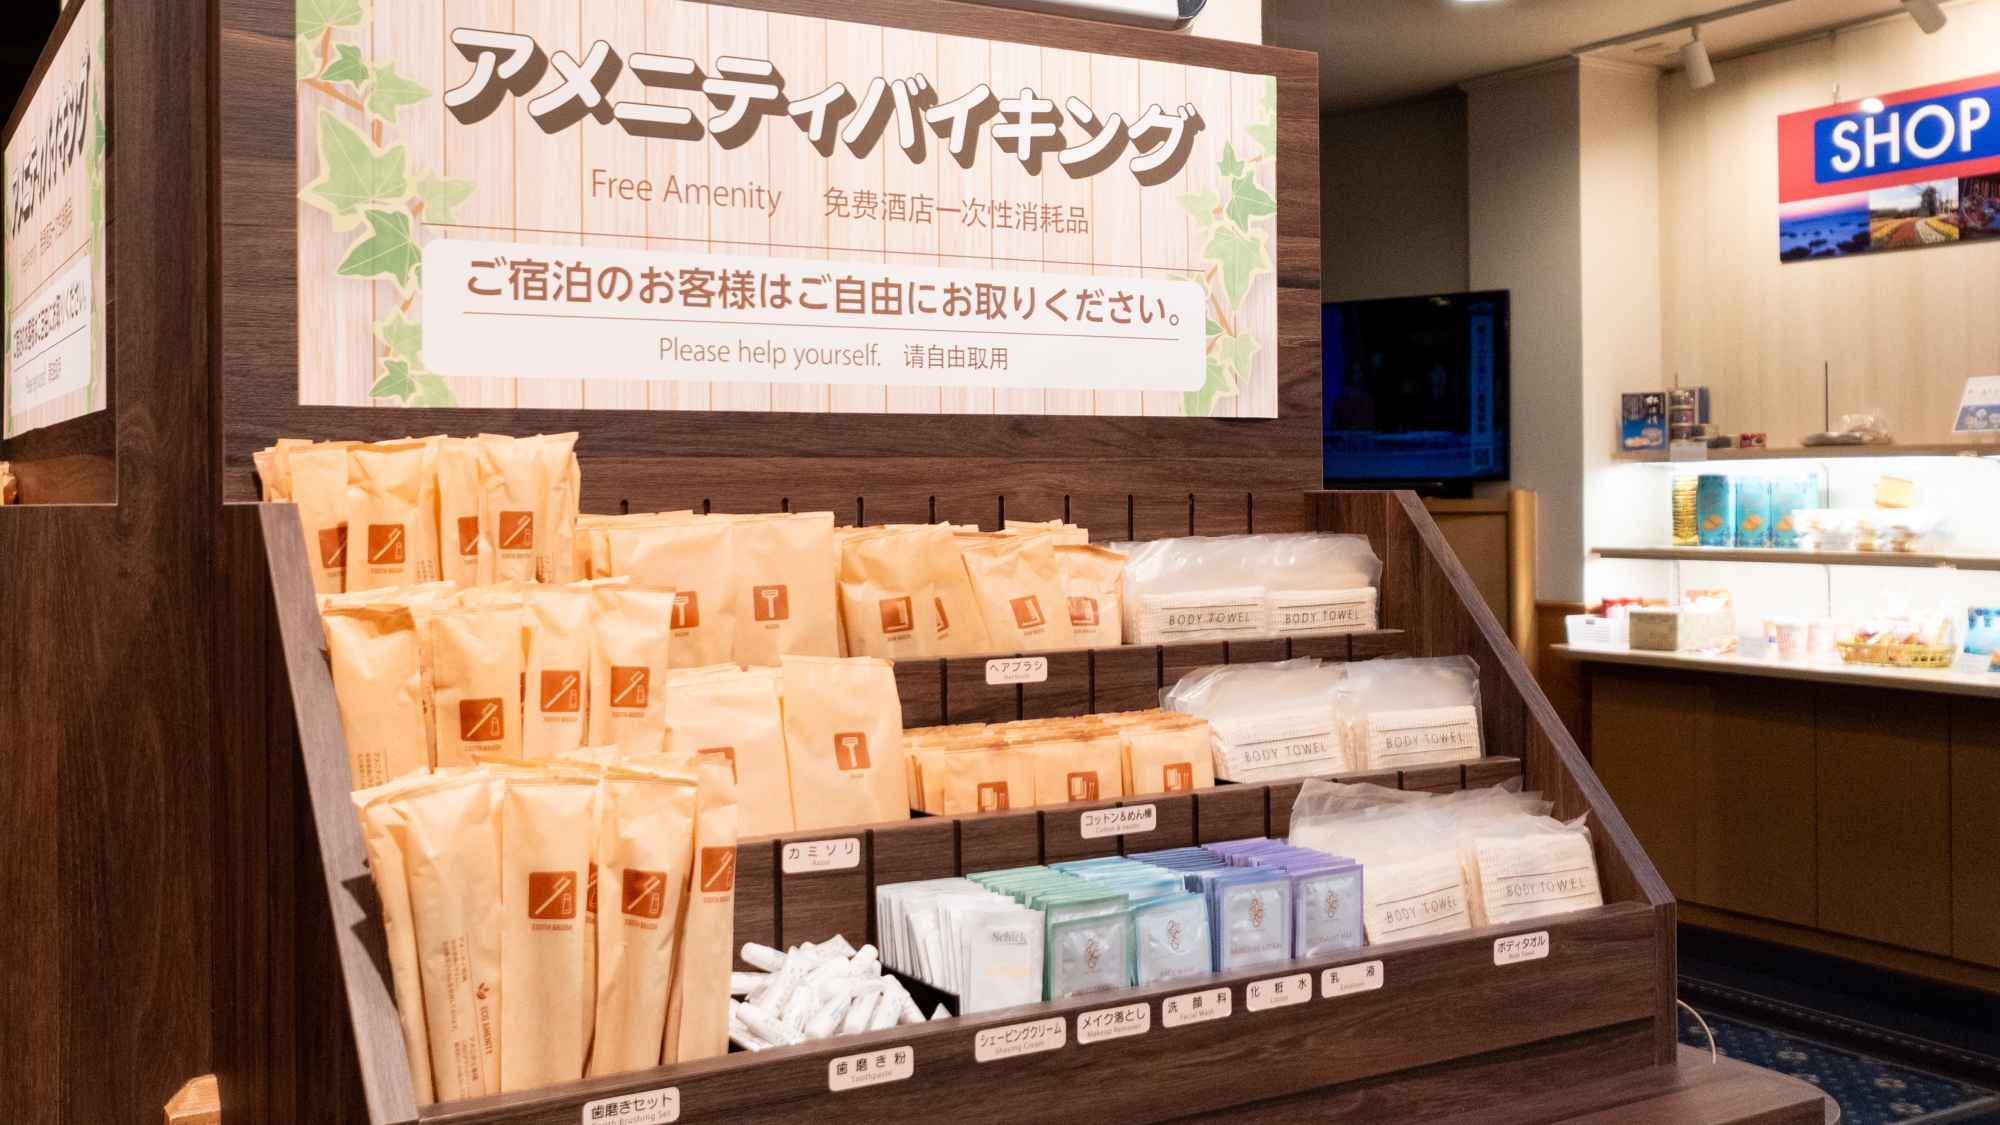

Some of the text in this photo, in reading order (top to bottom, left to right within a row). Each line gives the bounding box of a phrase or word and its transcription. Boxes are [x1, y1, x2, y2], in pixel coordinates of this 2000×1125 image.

[443, 27, 1206, 187] アメニティバイキング
[1831, 97, 1991, 173] SHOP
[592, 168, 782, 218] Free Amenity
[822, 186, 1090, 235] 免费酒店一次性消耗品
[467, 255, 1180, 326] ご宿泊のお客様はご自由にお取りください。
[660, 336, 882, 371] Please help yourself.
[903, 343, 1009, 371] 请自由取用
[1169, 612, 1251, 626] BODY TOWEL
[1285, 608, 1361, 624] BODY TOWEL
[989, 660, 1043, 674] ヘアブラシ
[1386, 731, 1466, 749] BODY TOWEL
[1245, 741, 1328, 763] BODY TOWEL
[789, 842, 854, 859] カミソリ
[1507, 877, 1586, 897] BODY TOWEL
[1387, 896, 1458, 924] BODY TOWEL
[532, 923, 573, 931] TOOTH BRUSH
[992, 930, 1028, 946] Schick
[1497, 935, 1546, 953] ボディタオル
[1509, 950, 1535, 960] Body Towel
[1161, 965, 1195, 977] FACE WASH
[1330, 965, 1375, 984] 乳液
[1250, 978, 1307, 998] 化粧水
[1340, 981, 1366, 991] Emulsion
[1168, 992, 1227, 1013] 洗顔料
[1270, 995, 1289, 1004] Lotion
[1082, 1008, 1146, 1029] メイク落とし
[1180, 1008, 1214, 1020] Facial Wash
[480, 1005, 494, 1054] ECO AMENITY
[980, 1022, 1062, 1047] シェービングクリーム
[1087, 1023, 1141, 1038] Makeup Remover
[995, 1040, 1045, 1055] Shaving Cream
[836, 1050, 906, 1075] 歯磨き粉
[851, 1070, 892, 1082] Toothpaste
[592, 1093, 672, 1119] 歯磨きセット
[620, 1112, 655, 1125] Brushing
[658, 1110, 671, 1118] Set
